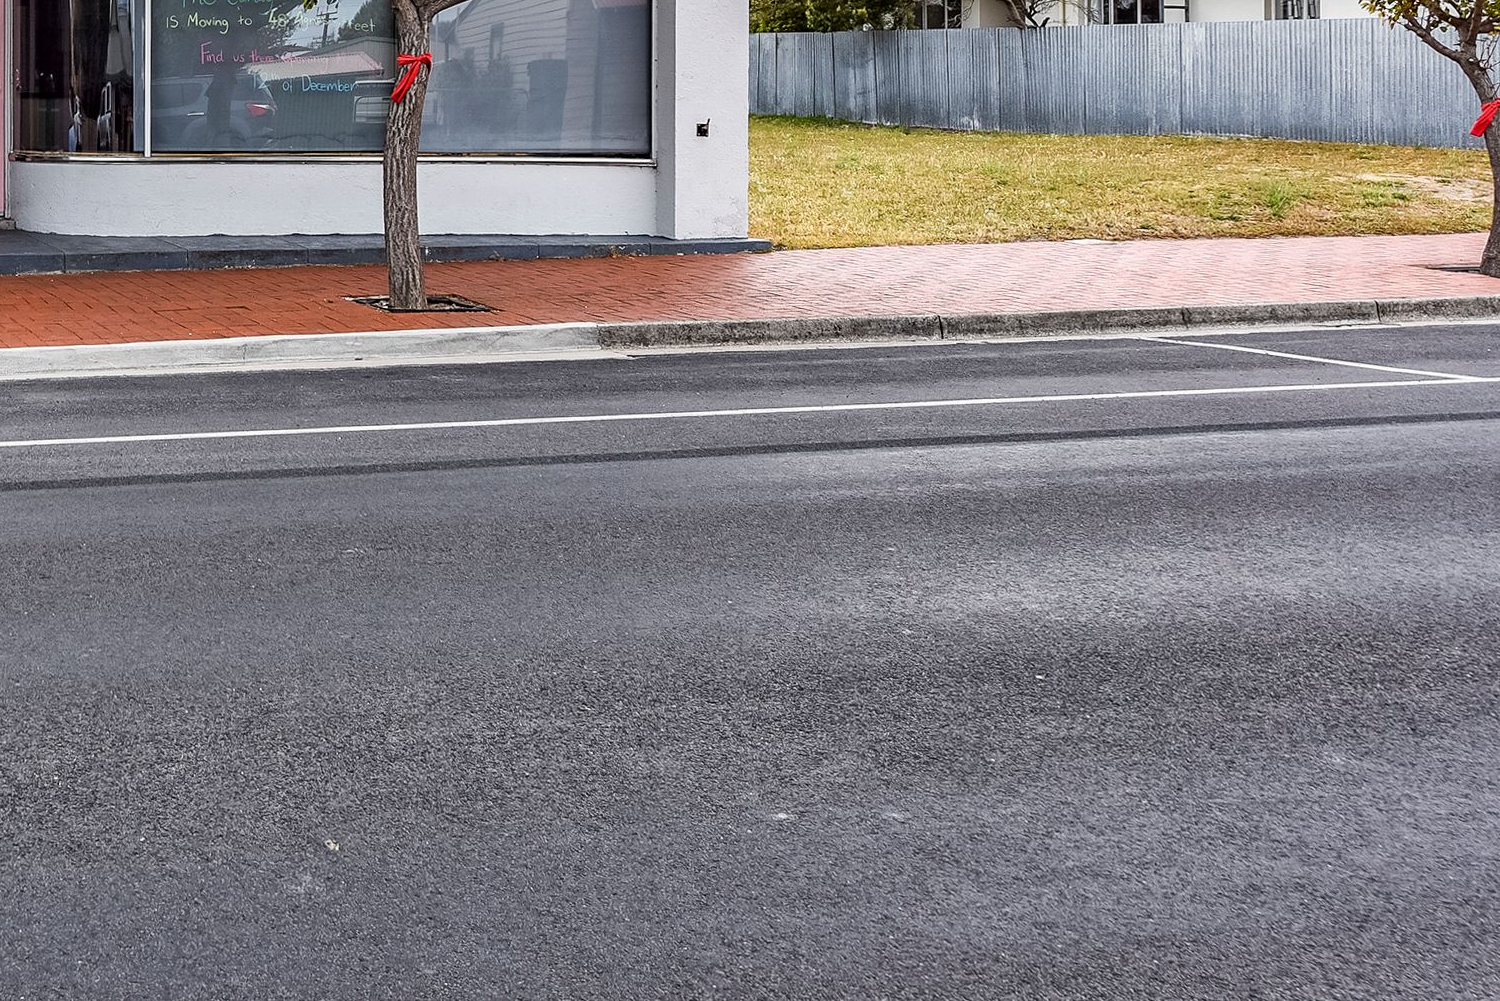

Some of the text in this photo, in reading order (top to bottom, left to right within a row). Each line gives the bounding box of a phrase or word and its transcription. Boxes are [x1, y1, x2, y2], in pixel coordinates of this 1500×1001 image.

[187, 11, 229, 35] Moving
[237, 14, 253, 26] to
[200, 40, 224, 65] Find
[232, 54, 245, 63] us
[301, 73, 357, 92] December
